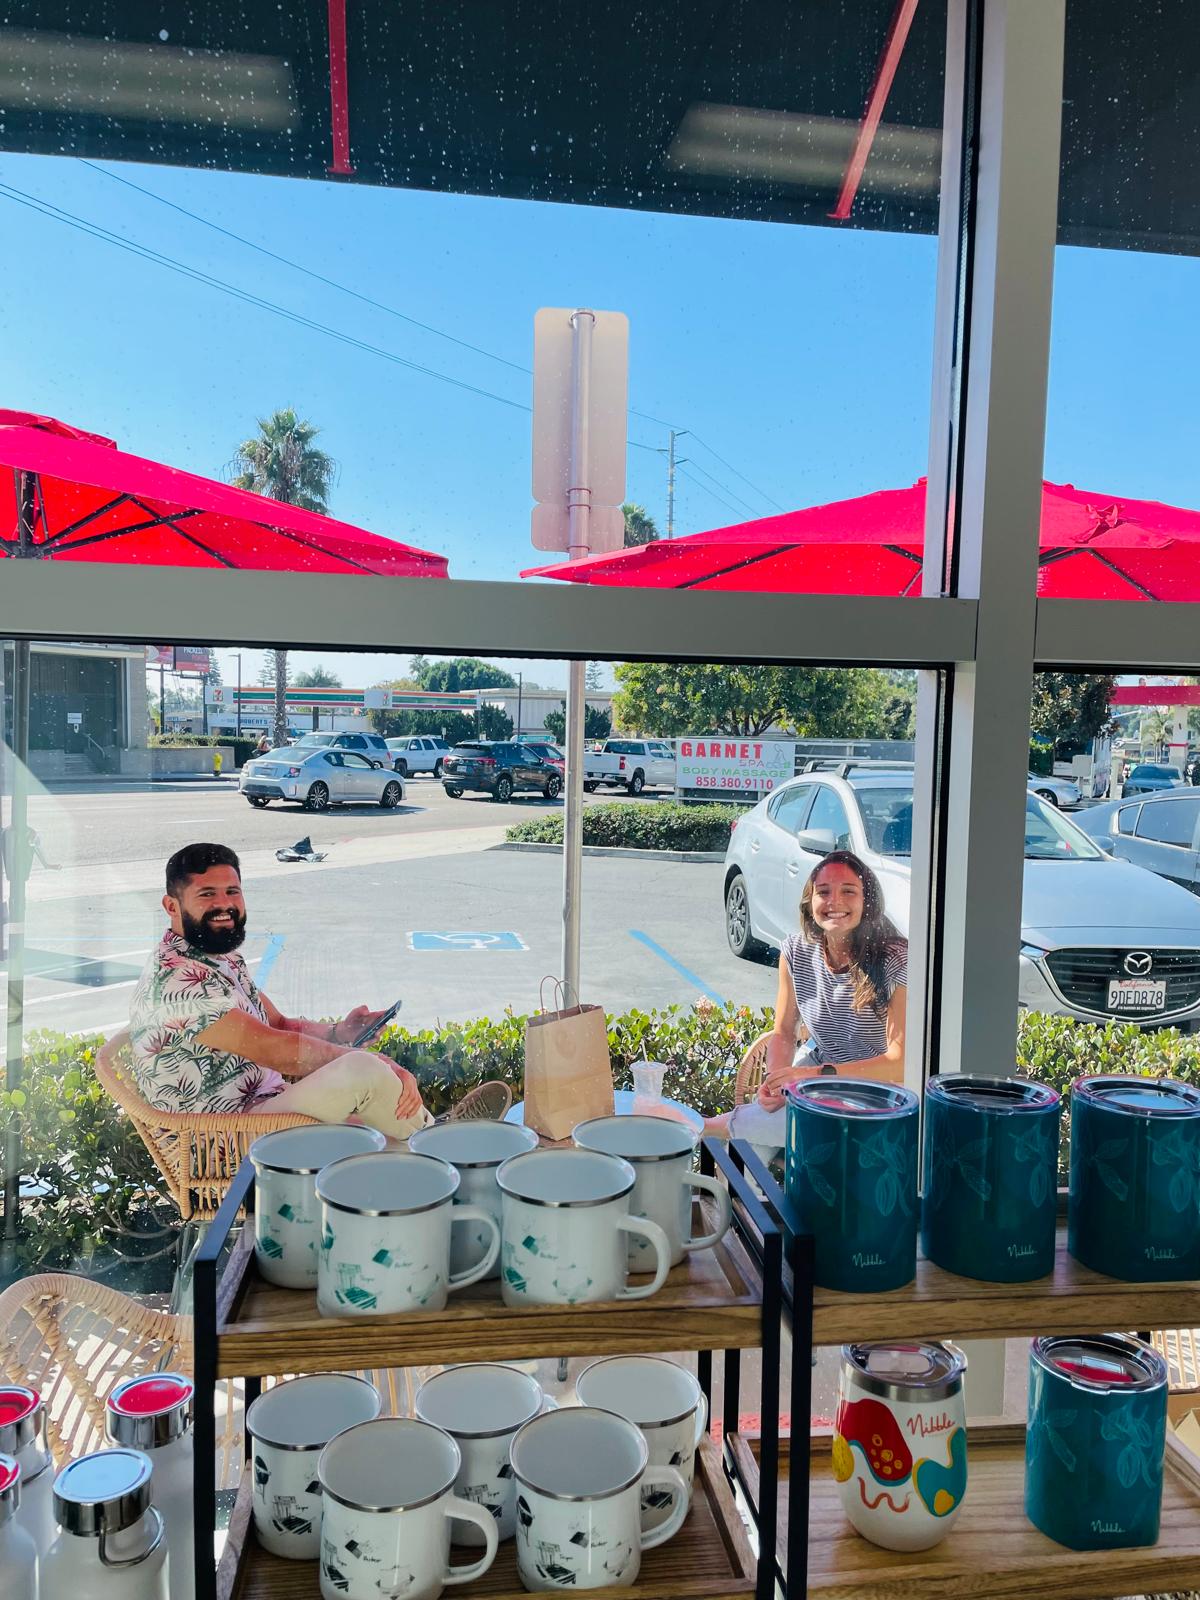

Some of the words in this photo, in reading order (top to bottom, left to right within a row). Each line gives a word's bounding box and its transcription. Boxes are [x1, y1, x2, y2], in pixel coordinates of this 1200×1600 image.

[681, 742, 763, 759] GARNET
[739, 760, 765, 768] SPA
[682, 767, 718, 775] BODY
[722, 768, 787, 777] MASSAGE
[696, 777, 773, 789] 858.380.9110
[907, 1412, 955, 1438] Nibble
